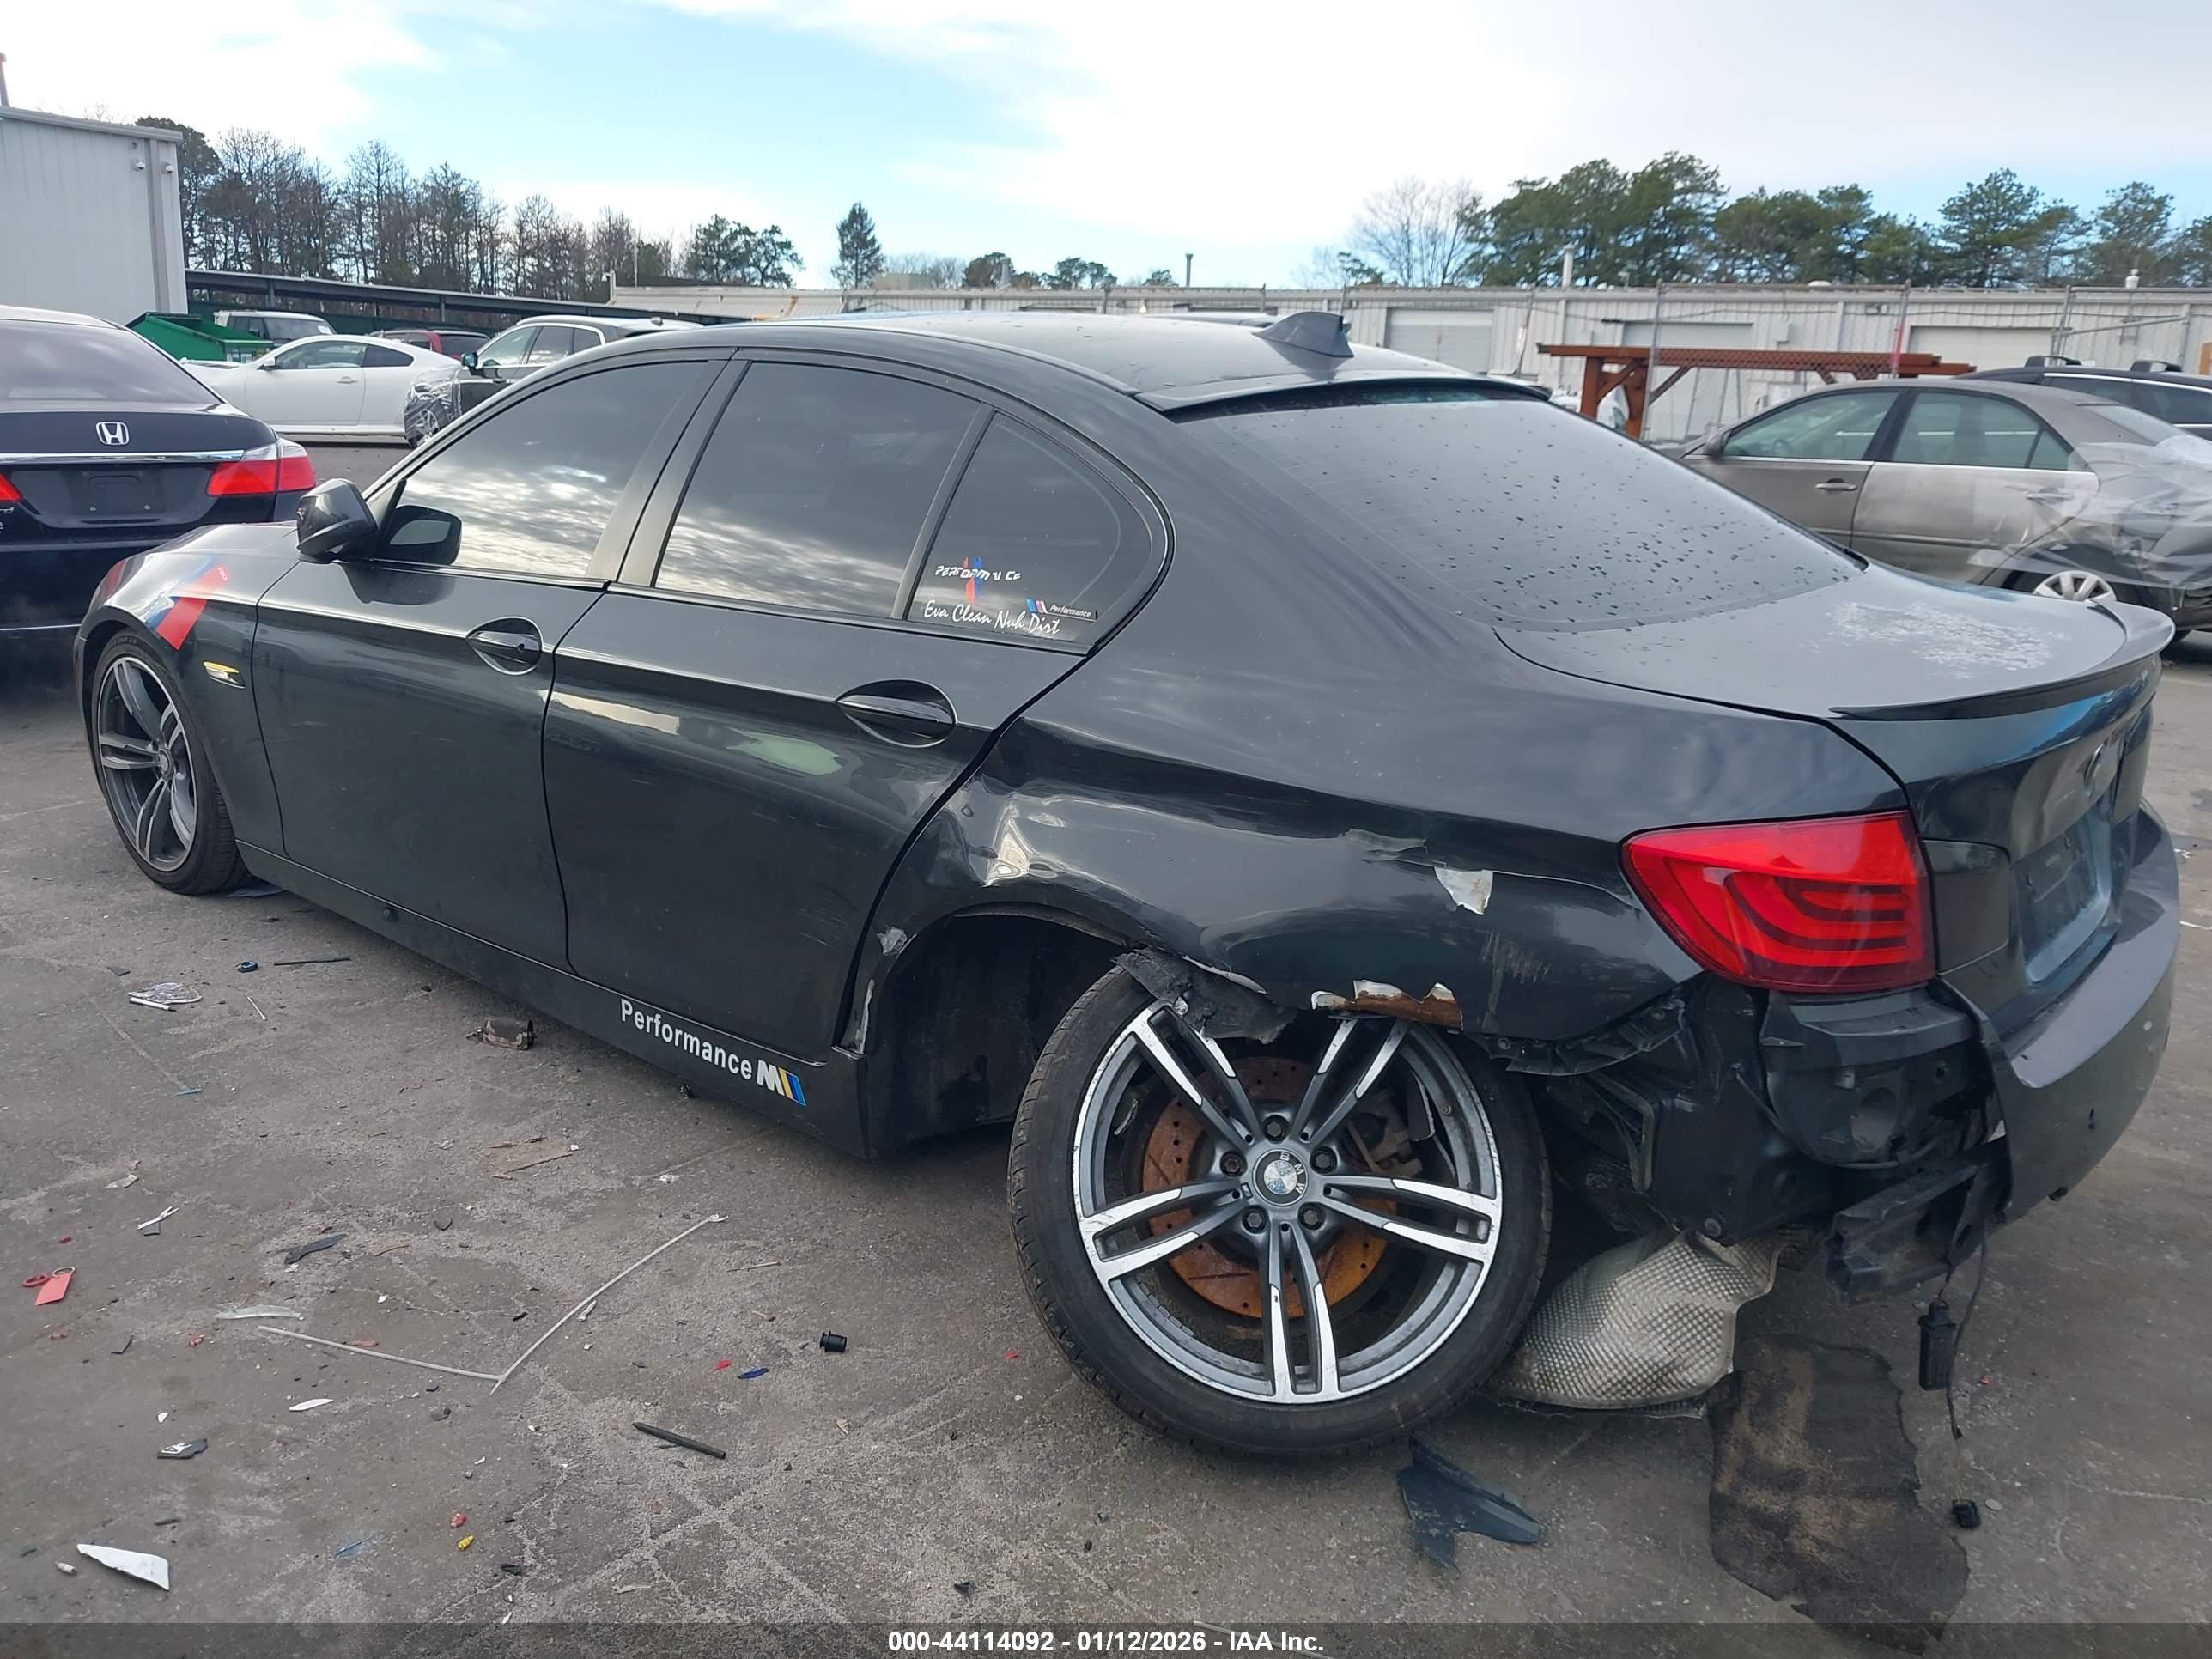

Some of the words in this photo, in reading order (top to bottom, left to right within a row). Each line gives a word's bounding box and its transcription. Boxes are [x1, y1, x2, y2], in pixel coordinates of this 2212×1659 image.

[923, 599, 950, 618] Eva
[951, 604, 993, 624] Clean
[994, 610, 1025, 629] Nuh
[1026, 612, 1061, 635] Dirt
[1049, 604, 1092, 618] Performance
[620, 997, 753, 1080] Performance
[1279, 1151, 1306, 1194] BMW
